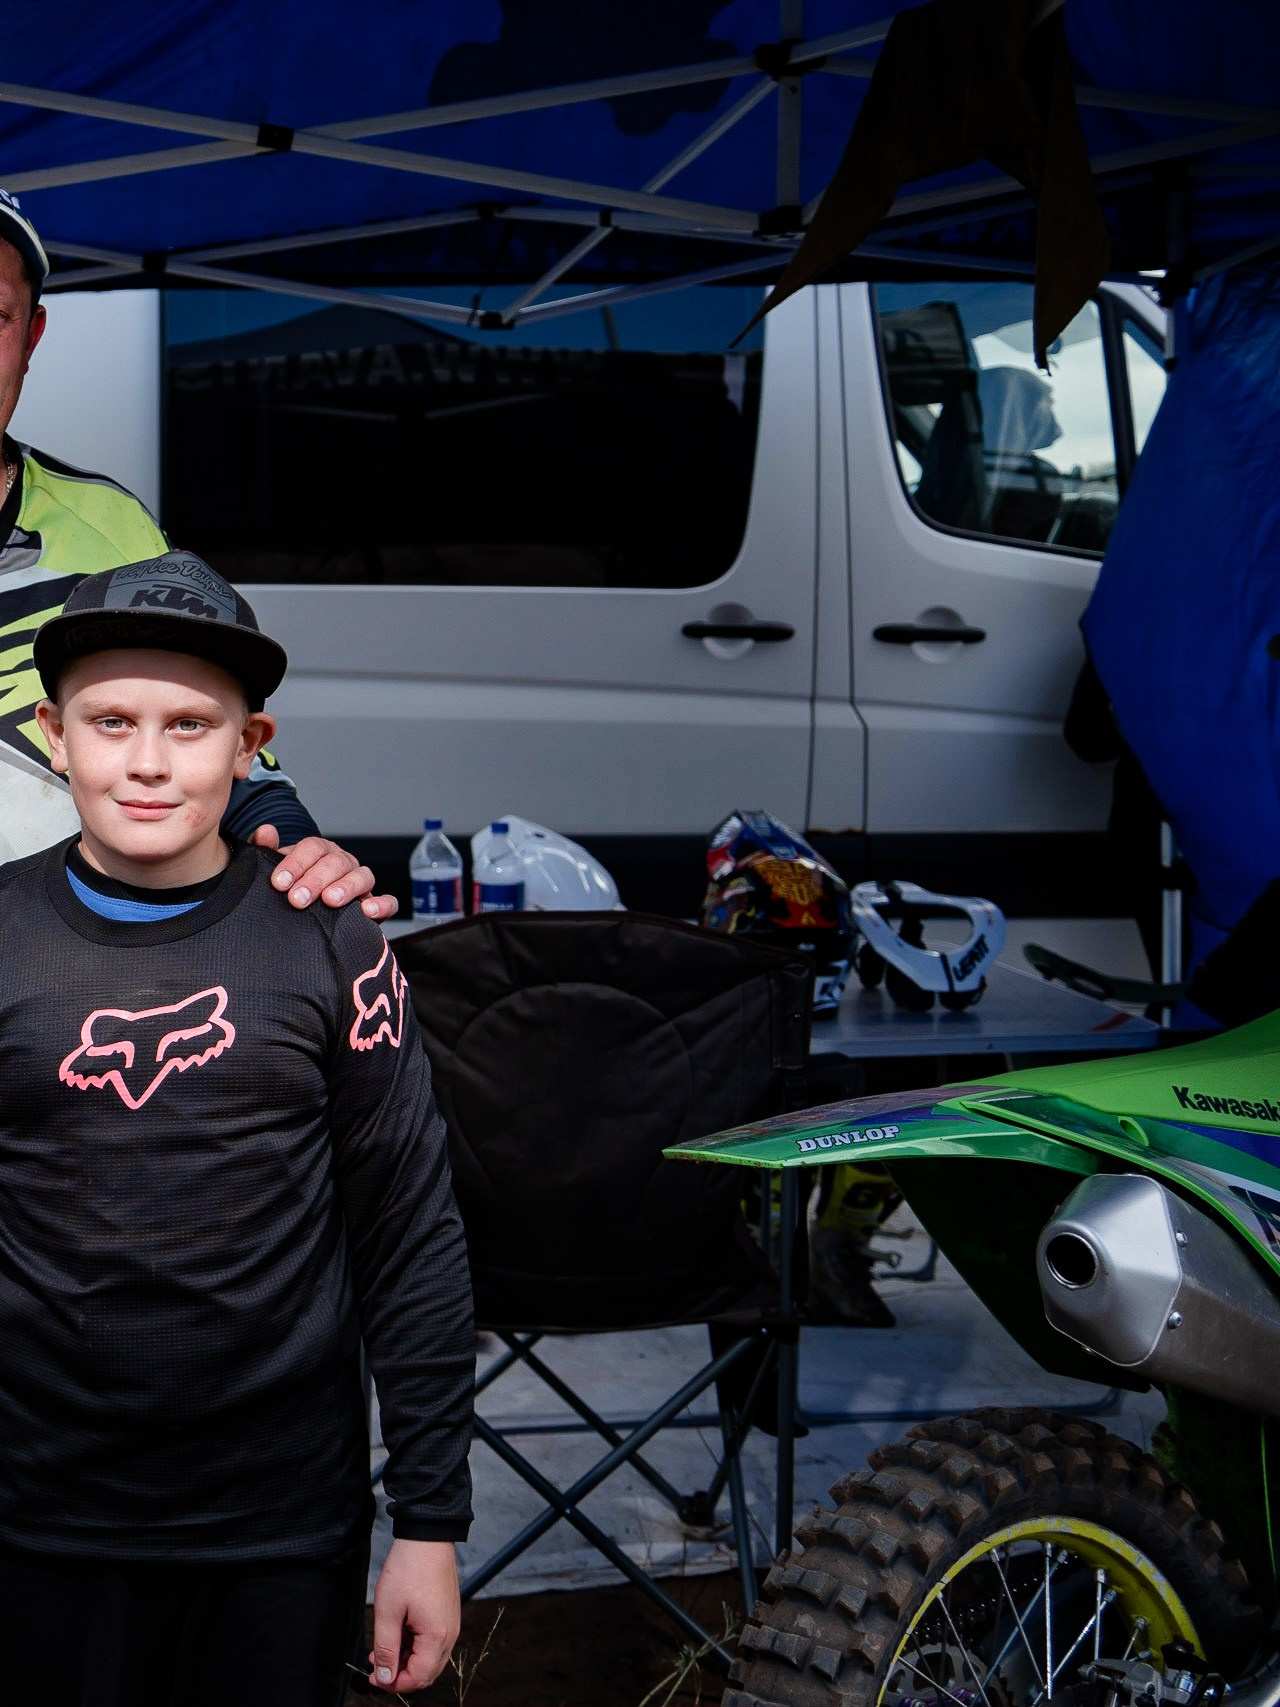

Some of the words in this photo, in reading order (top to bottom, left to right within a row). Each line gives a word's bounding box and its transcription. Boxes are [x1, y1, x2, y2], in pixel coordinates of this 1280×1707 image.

[147, 558, 180, 574] Lee
[129, 584, 218, 620] KTM
[953, 934, 991, 980] LEATT
[796, 1125, 901, 1153] DUNLOP
